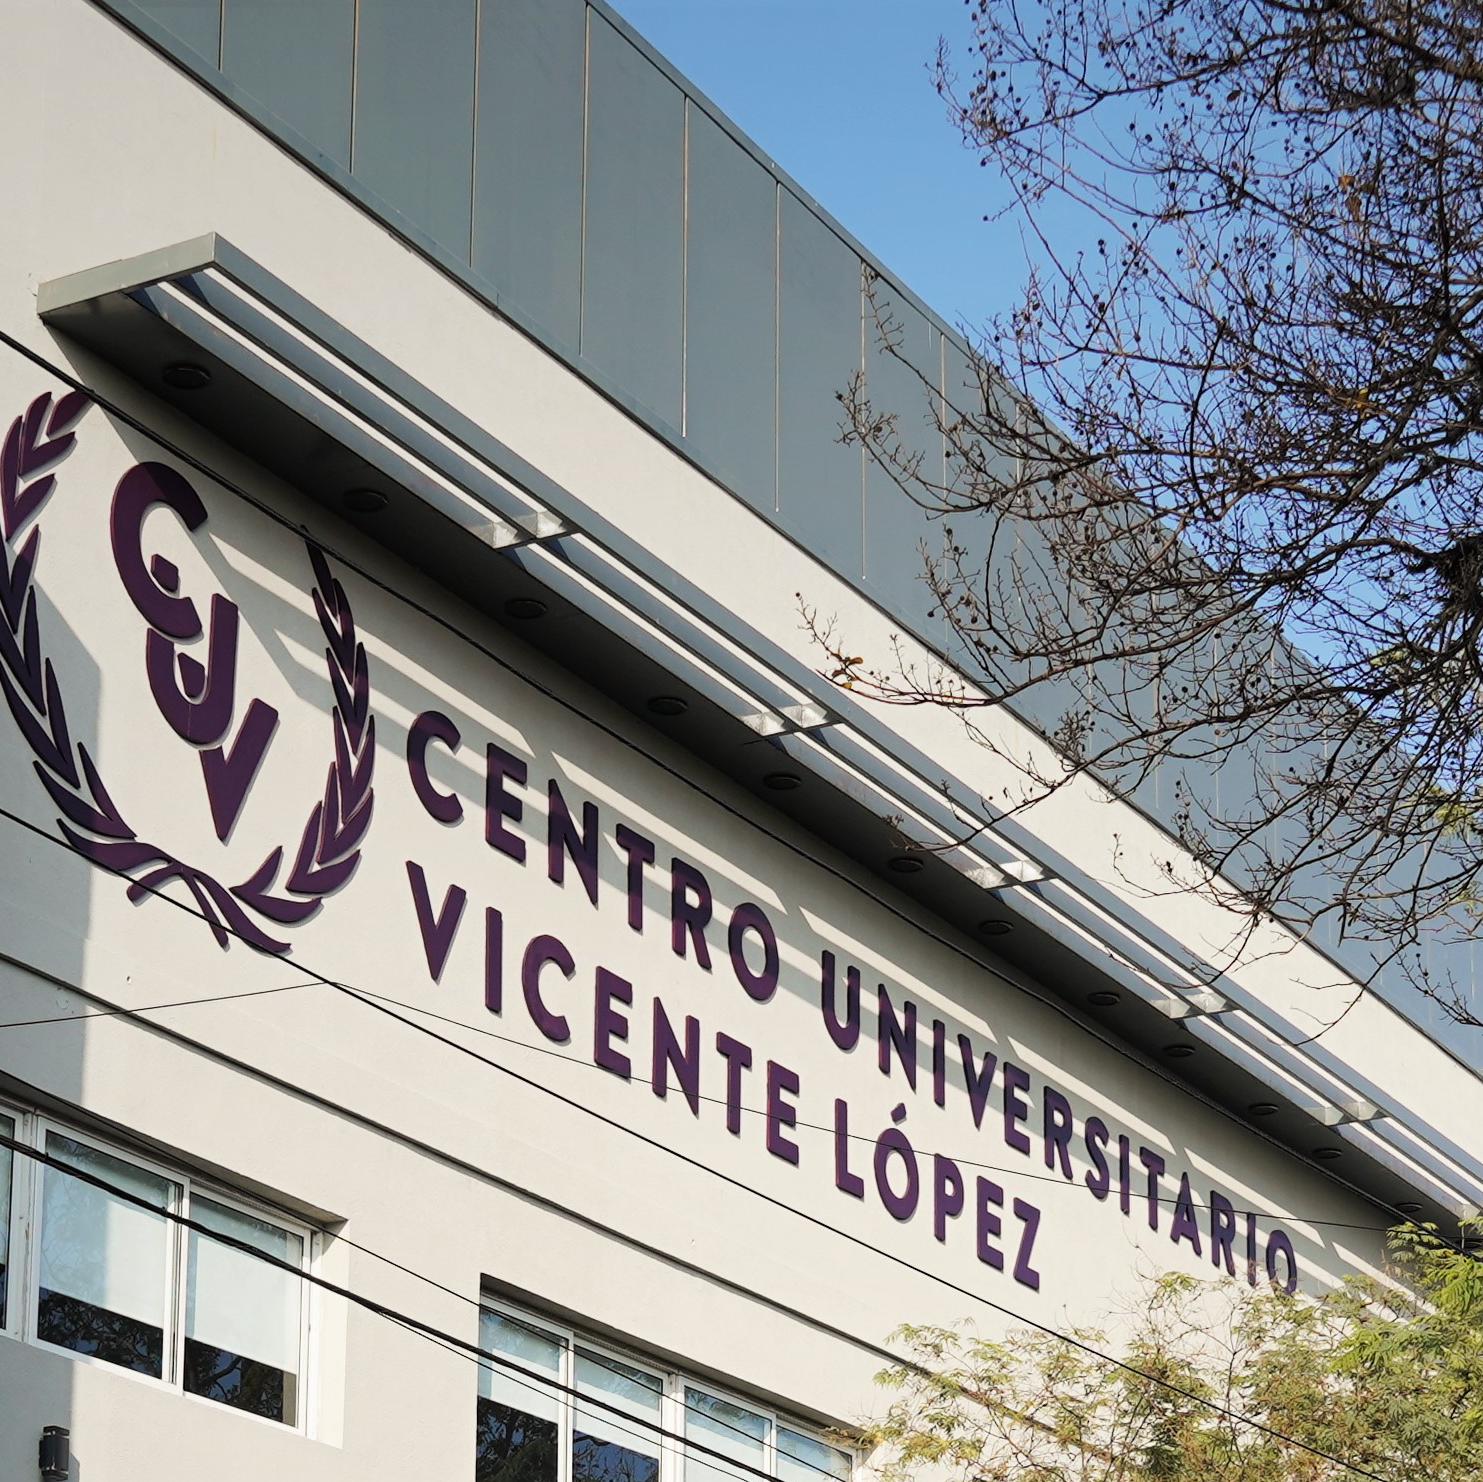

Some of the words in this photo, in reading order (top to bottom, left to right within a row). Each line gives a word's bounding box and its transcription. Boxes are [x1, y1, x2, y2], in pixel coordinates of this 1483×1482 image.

[405, 860, 802, 1166] VICENTE
[833, 1098, 1043, 1292] LÓPEZ
[406, 709, 780, 1002] CENTRO
[820, 948, 1299, 1297] UNIVERSITARIO
